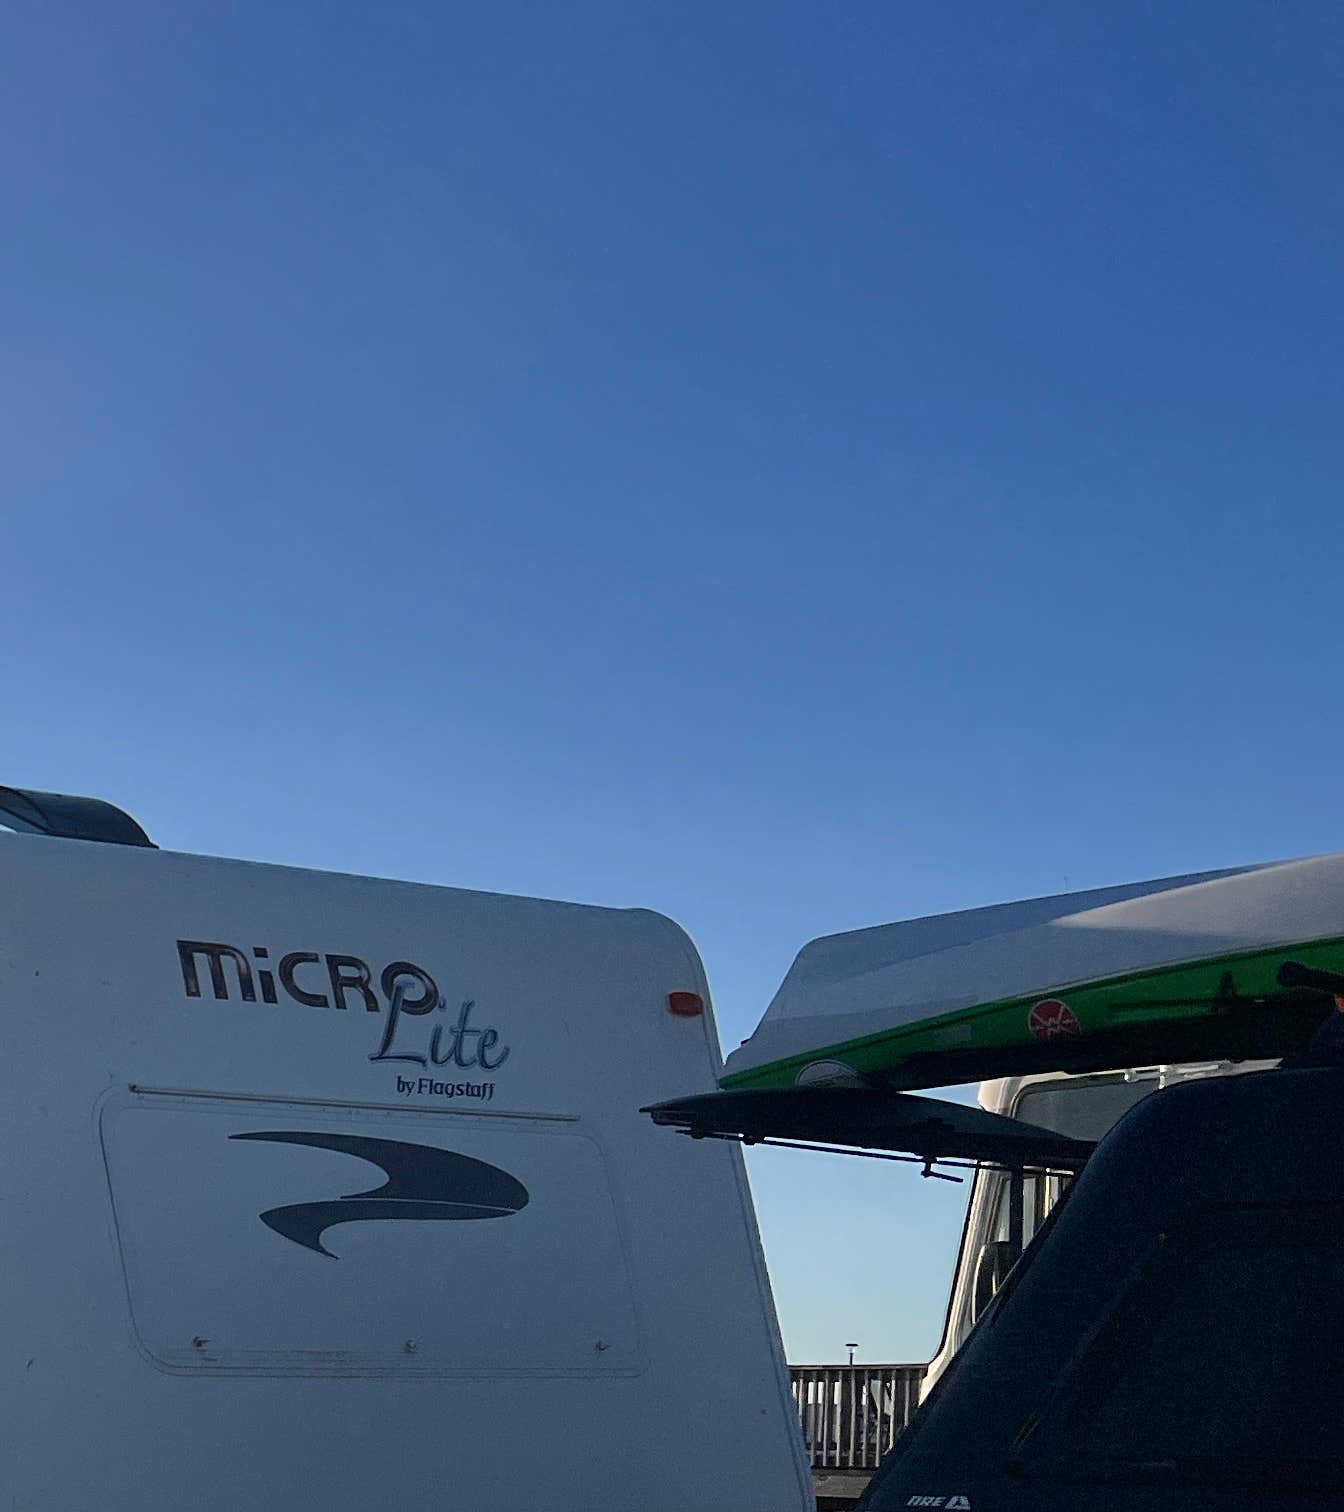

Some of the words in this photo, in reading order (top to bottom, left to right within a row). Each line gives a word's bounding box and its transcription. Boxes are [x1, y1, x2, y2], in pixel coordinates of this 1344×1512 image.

[368, 980, 511, 1071] Lite
[396, 1076, 416, 1097] by
[417, 1078, 496, 1101] Flagstaff
